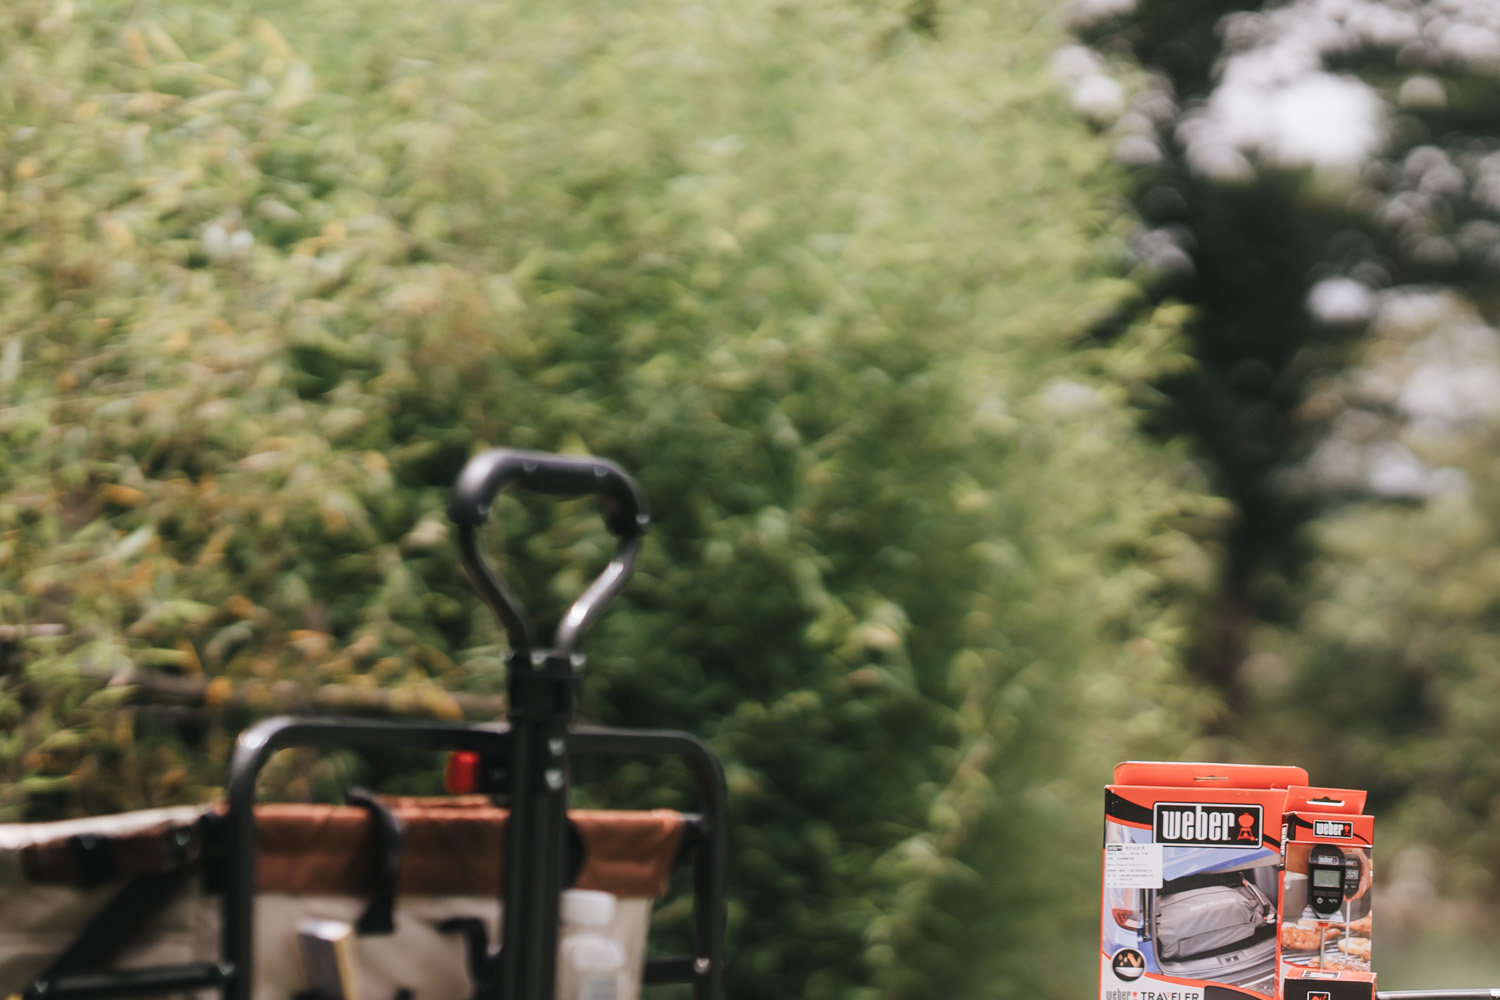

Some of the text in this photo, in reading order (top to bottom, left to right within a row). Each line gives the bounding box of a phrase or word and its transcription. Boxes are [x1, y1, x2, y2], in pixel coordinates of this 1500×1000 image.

[1161, 805, 1235, 841] weber
[1316, 821, 1344, 835] weber
[1106, 988, 1131, 1000] weber
